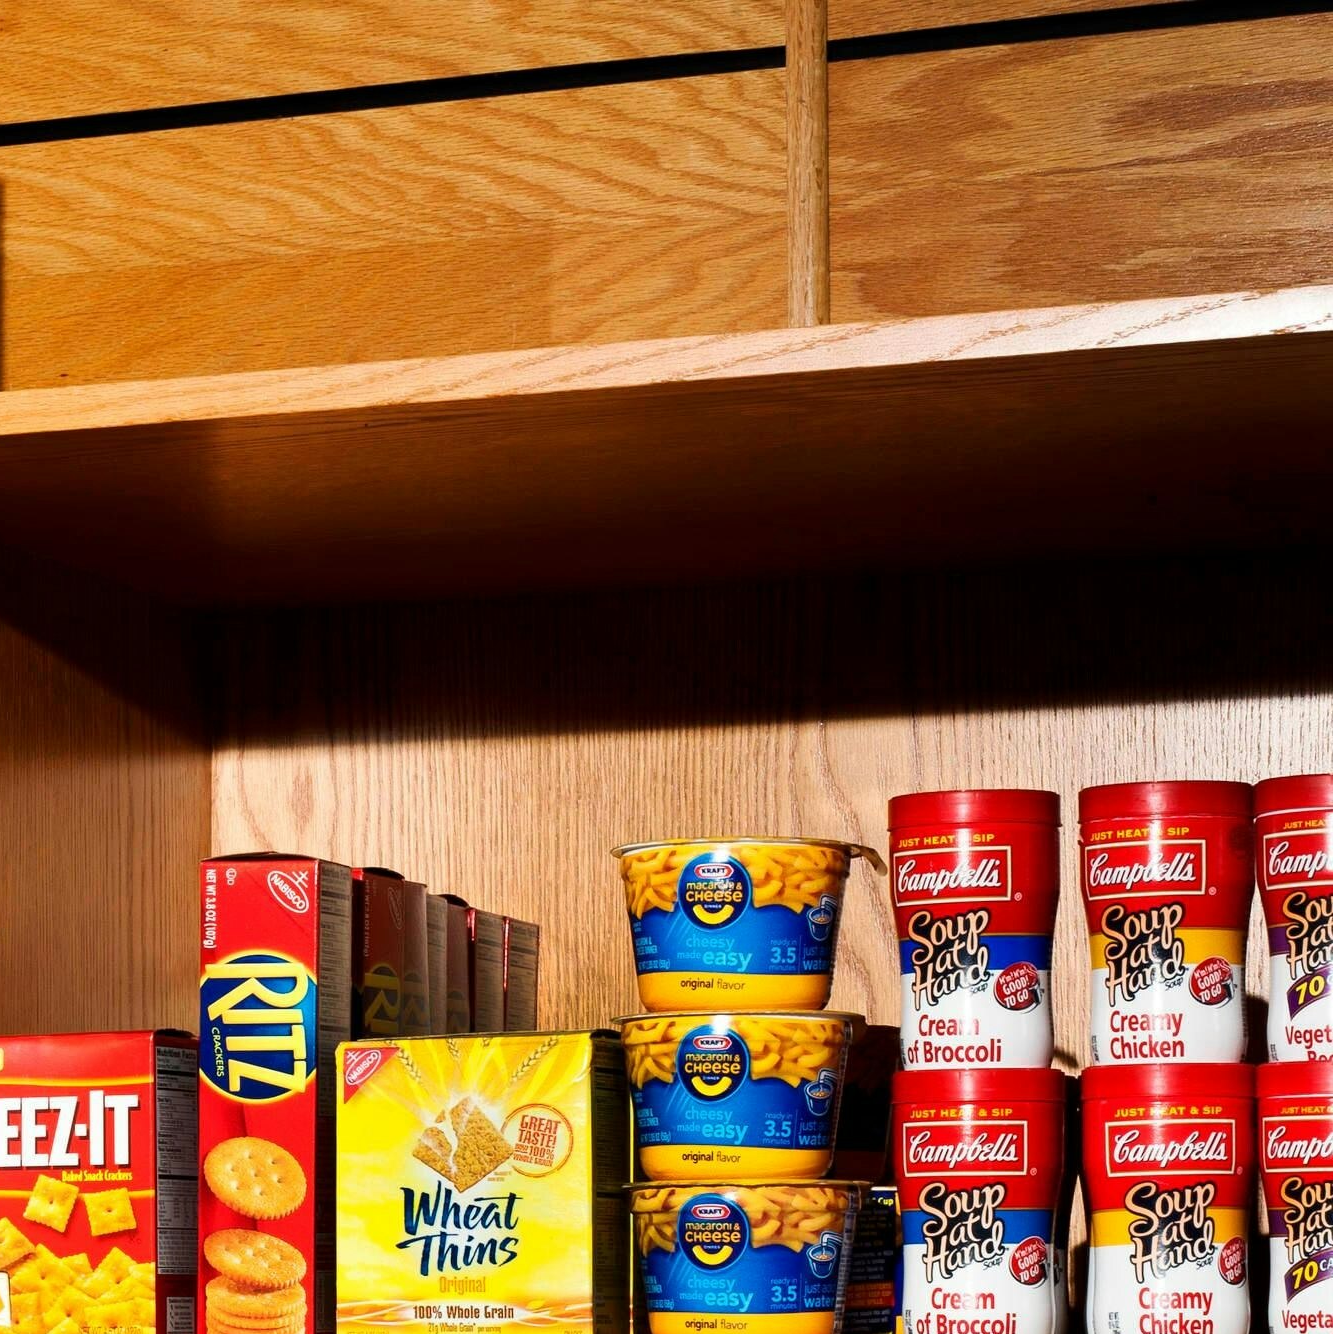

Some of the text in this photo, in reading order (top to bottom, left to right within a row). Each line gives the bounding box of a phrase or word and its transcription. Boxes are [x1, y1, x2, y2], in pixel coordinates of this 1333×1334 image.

[899, 834, 994, 848] JUST HEAT SIP
[270, 873, 306, 911] NABISCO
[702, 951, 753, 972] easy
[770, 948, 797, 964] 3.5
[681, 979, 746, 990] original flavor
[205, 963, 308, 1093] RITZ
[1110, 1011, 1183, 1037] Creamy
[212, 1027, 224, 1077] CRACKERS
[924, 1039, 1002, 1063] Broccoli
[1110, 1035, 1185, 1059] Chicken
[348, 1051, 379, 1083] NABISCO
[910, 1110, 935, 1118] JUST
[520, 1115, 562, 1134] GREAT
[702, 1124, 748, 1144] easy
[764, 1121, 792, 1137] 3.5
[518, 1130, 557, 1149] TASTE!
[682, 1152, 741, 1163] original flavor
[400, 1180, 523, 1236] Wheat
[395, 1232, 519, 1276] Thins
[439, 1277, 486, 1295] Original
[771, 1286, 797, 1302] 3.5
[705, 1291, 753, 1312] easy
[412, 1305, 514, 1319] 100% Whole Grain
[685, 1319, 748, 1331] original flavor
